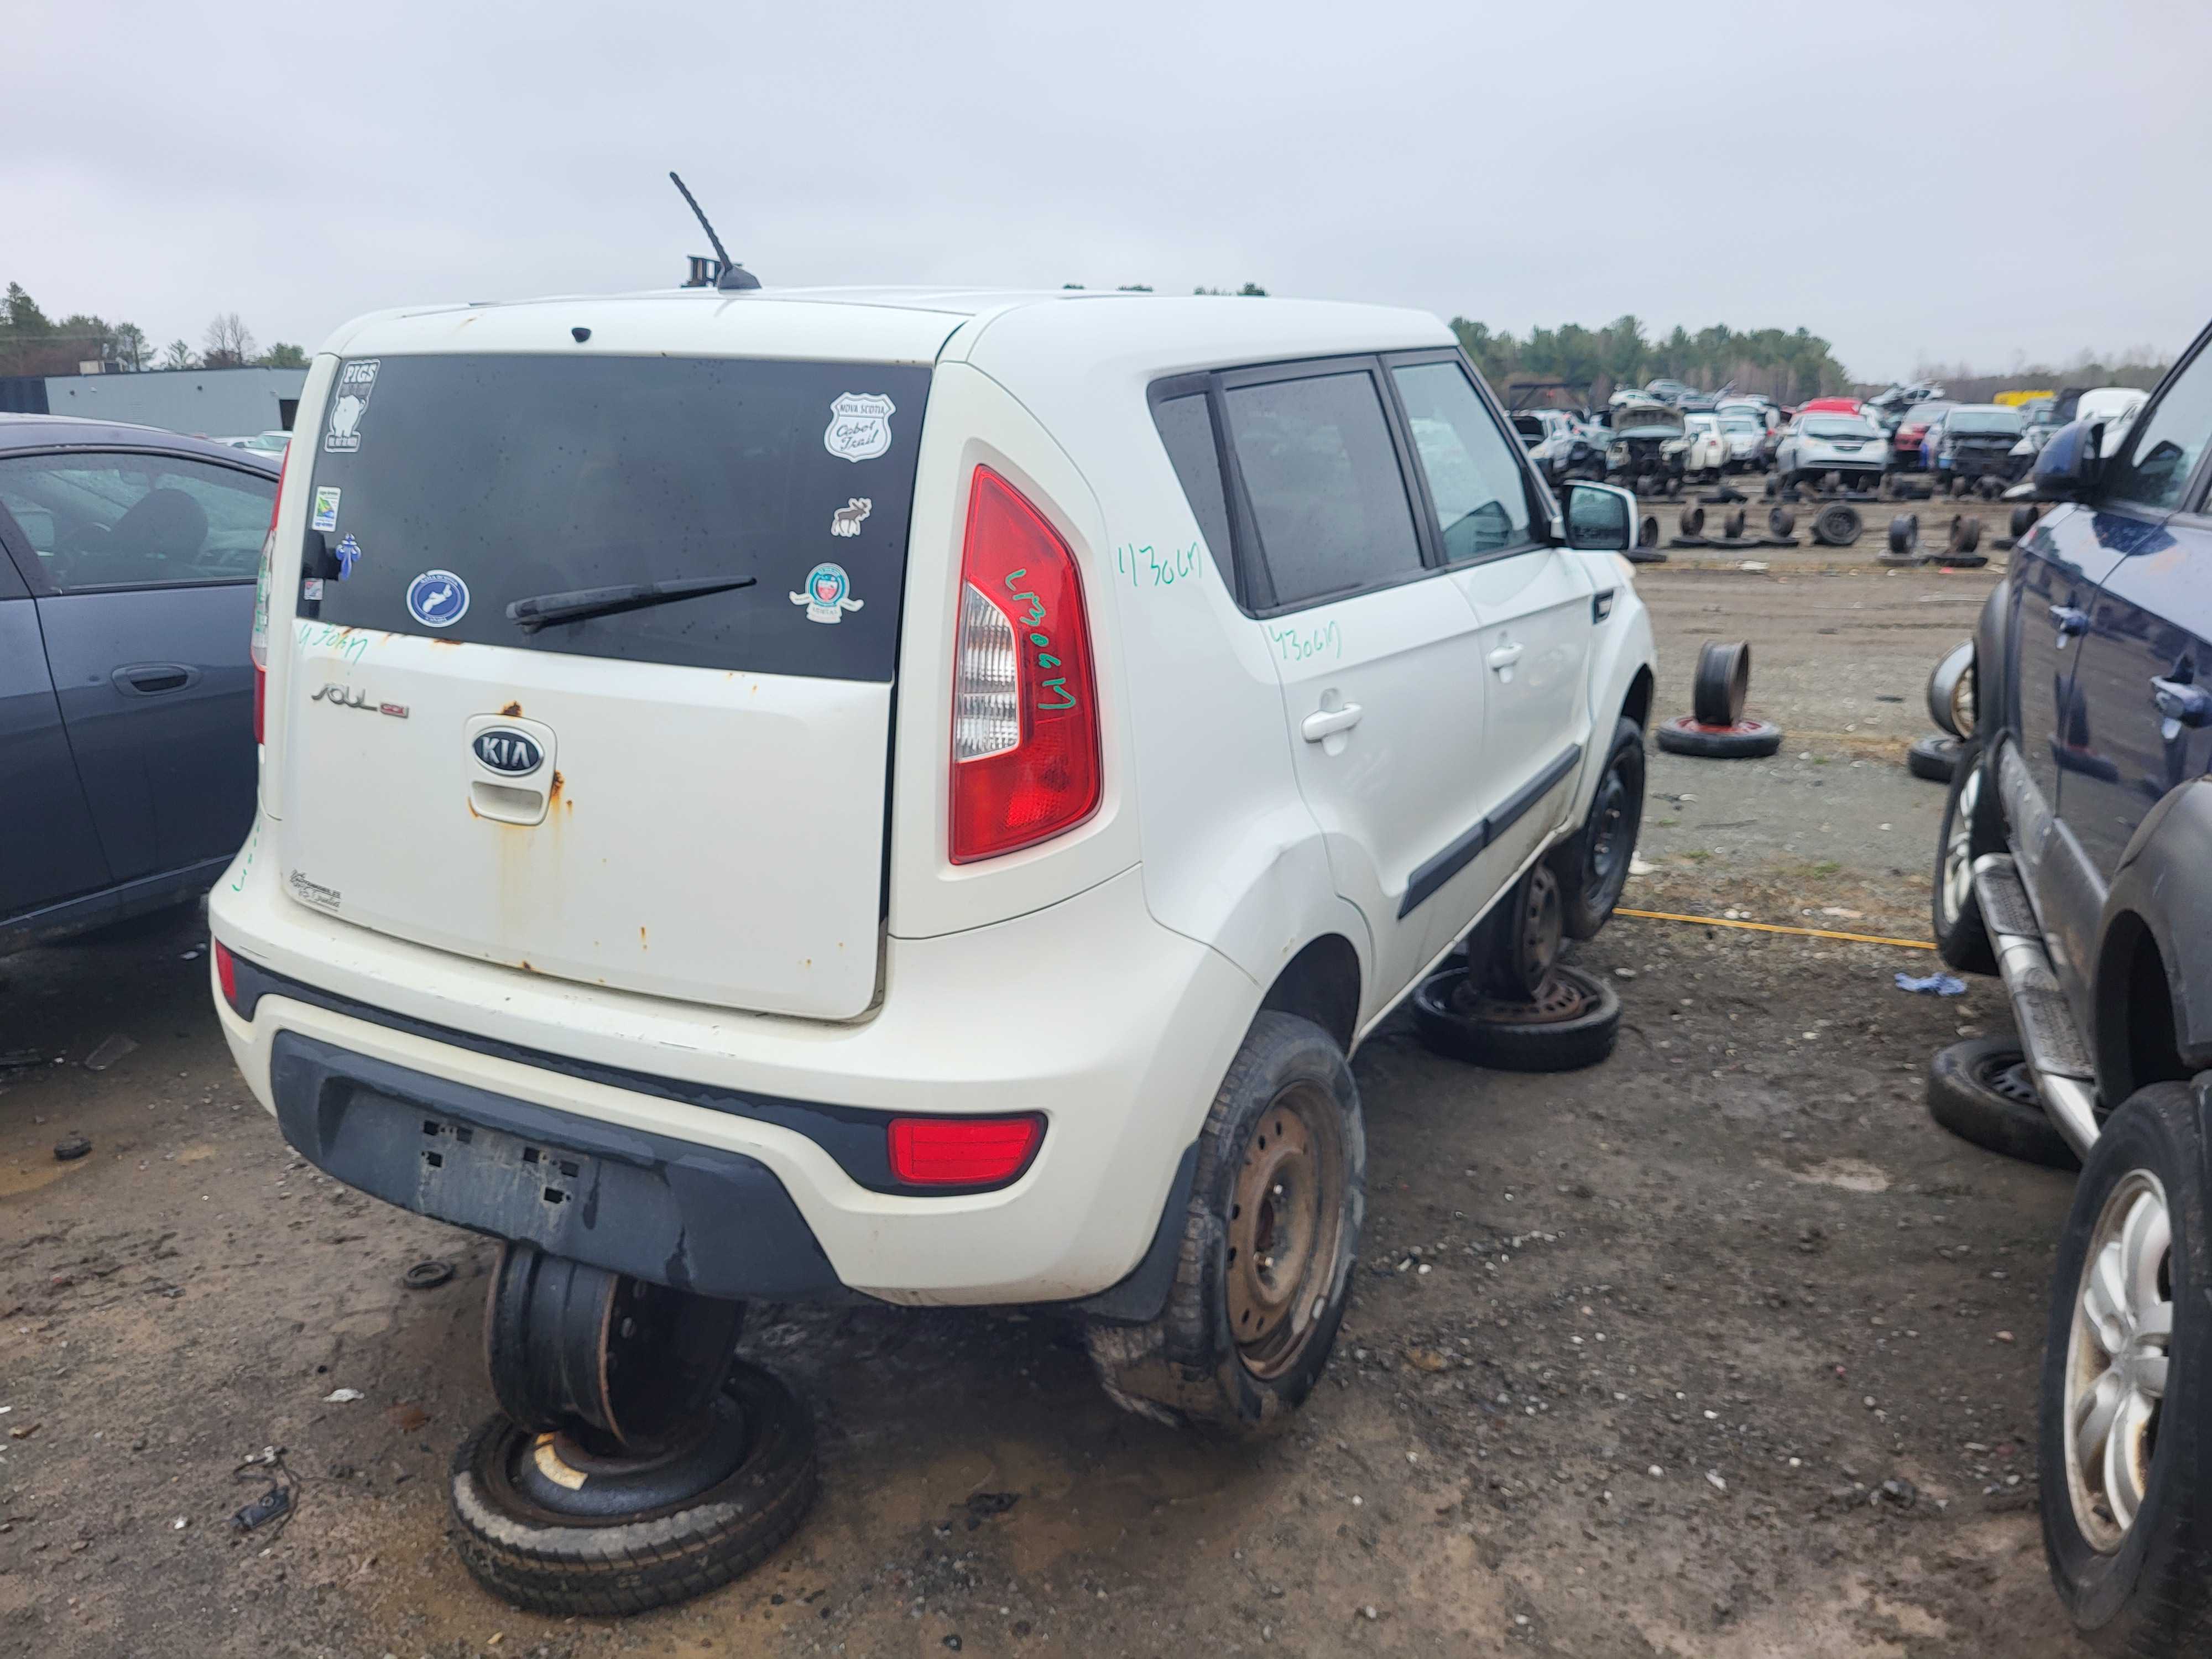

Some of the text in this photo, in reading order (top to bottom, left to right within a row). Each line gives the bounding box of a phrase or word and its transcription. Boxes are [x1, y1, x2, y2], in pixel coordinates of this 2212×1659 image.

[343, 363, 377, 383] PIGS
[840, 404, 885, 414] NOVA SCOTIA
[840, 429, 879, 451] Trail
[482, 735, 531, 768] KIA
